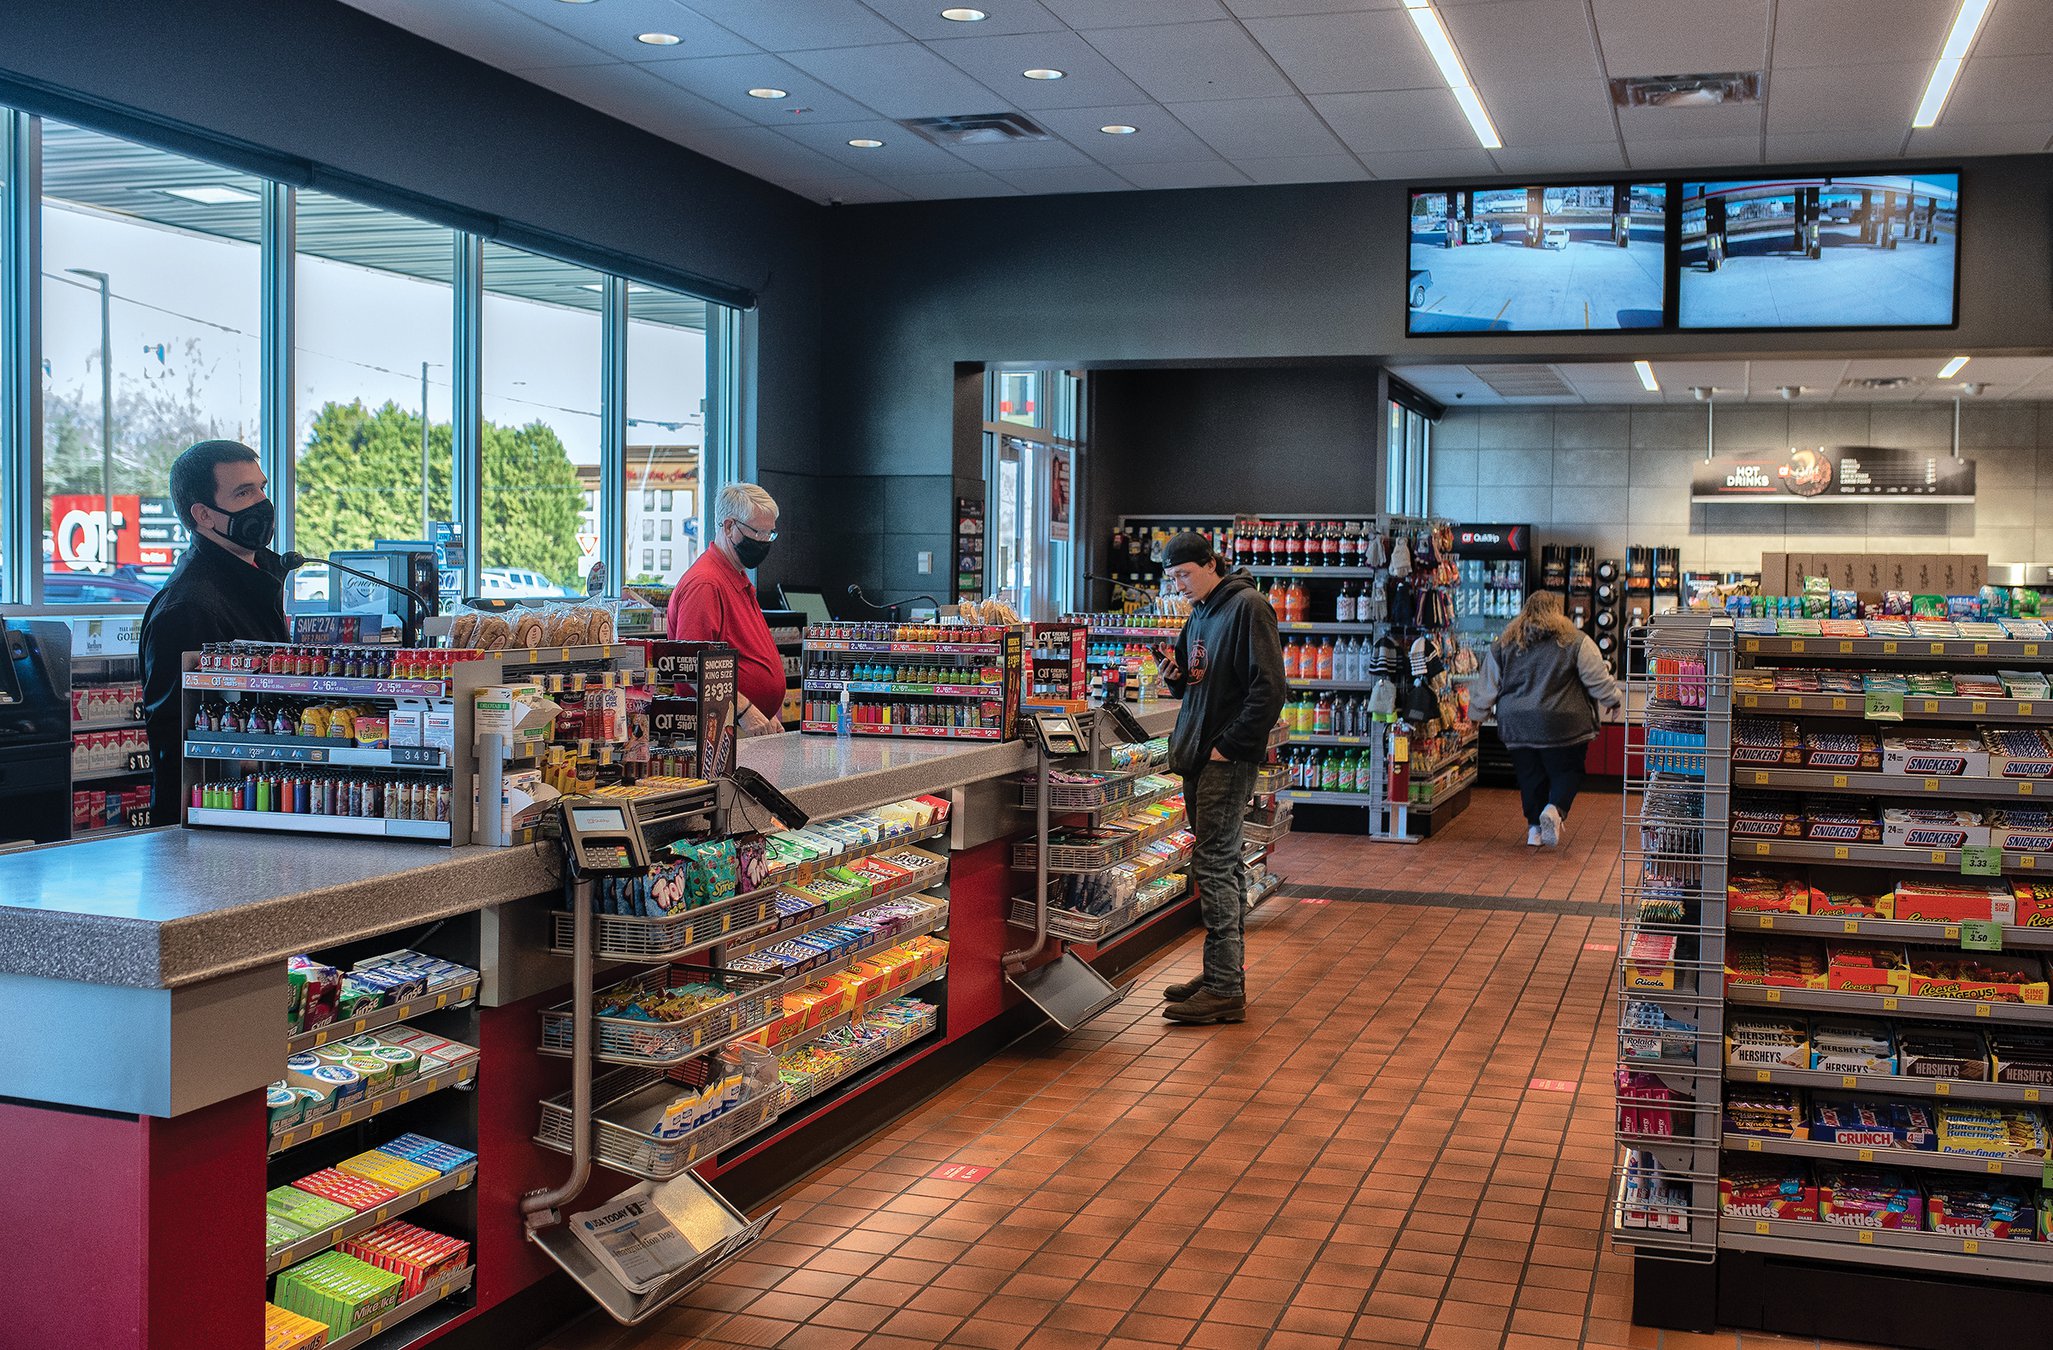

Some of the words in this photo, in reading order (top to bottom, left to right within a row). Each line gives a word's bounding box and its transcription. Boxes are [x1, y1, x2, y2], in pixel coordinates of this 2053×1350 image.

[1736, 466, 1760, 477] HOT
[1726, 475, 1770, 487] DRINKS
[58, 509, 124, 575] QT
[297, 618, 317, 633] SAVE
[117, 632, 141, 642] GOLD
[1039, 632, 1052, 642] QT
[658, 656, 676, 672] QT
[705, 660, 734, 670] SNICKERS
[705, 671, 720, 680] KING
[720, 670, 733, 679] SIZE
[1037, 668, 1050, 679] QT
[704, 685, 711, 697] 2
[604, 695, 618, 703] Clear
[655, 714, 674, 730] QT
[1734, 748, 1781, 761] SNICKERS
[1811, 753, 1858, 766] SNICKERS
[1887, 753, 1896, 761] 24
[1908, 758, 1960, 771] SNICKERS
[2006, 762, 2053, 774] SNICKERS
[1734, 821, 1781, 834] SNICKERS
[1811, 825, 1859, 838] SNICKERS
[1887, 825, 1896, 833] 24
[1908, 831, 1960, 844] SNICKERS
[2006, 836, 2053, 848] SNICKERS
[1969, 859, 1987, 868] 3.33
[1969, 934, 1988, 942] 3.50
[1634, 978, 1664, 987] Ricola
[1840, 981, 1872, 991] Reese's
[1918, 982, 1961, 996] Reese's
[1626, 1037, 1658, 1047] Rolaids
[1739, 1049, 1782, 1063] HERSHEY'S
[1825, 1062, 1869, 1074] HERSHEY'S
[1915, 1063, 1960, 1076] HERSHEY'S
[2006, 1068, 2053, 1083] HERSHEY'S
[1837, 1132, 1893, 1146] CRUNCH
[1907, 1134, 1914, 1142] 4
[1722, 1203, 1780, 1218] Skittles
[592, 1216, 604, 1229] USA
[603, 1208, 629, 1225] TODAY
[1824, 1212, 1883, 1228] Skittles
[1935, 1223, 1996, 1239] Skittles
[612, 1235, 660, 1258] Inauguration
[659, 1228, 675, 1242] Day
[353, 1302, 379, 1322] Mike
[379, 1294, 396, 1311] Ike
